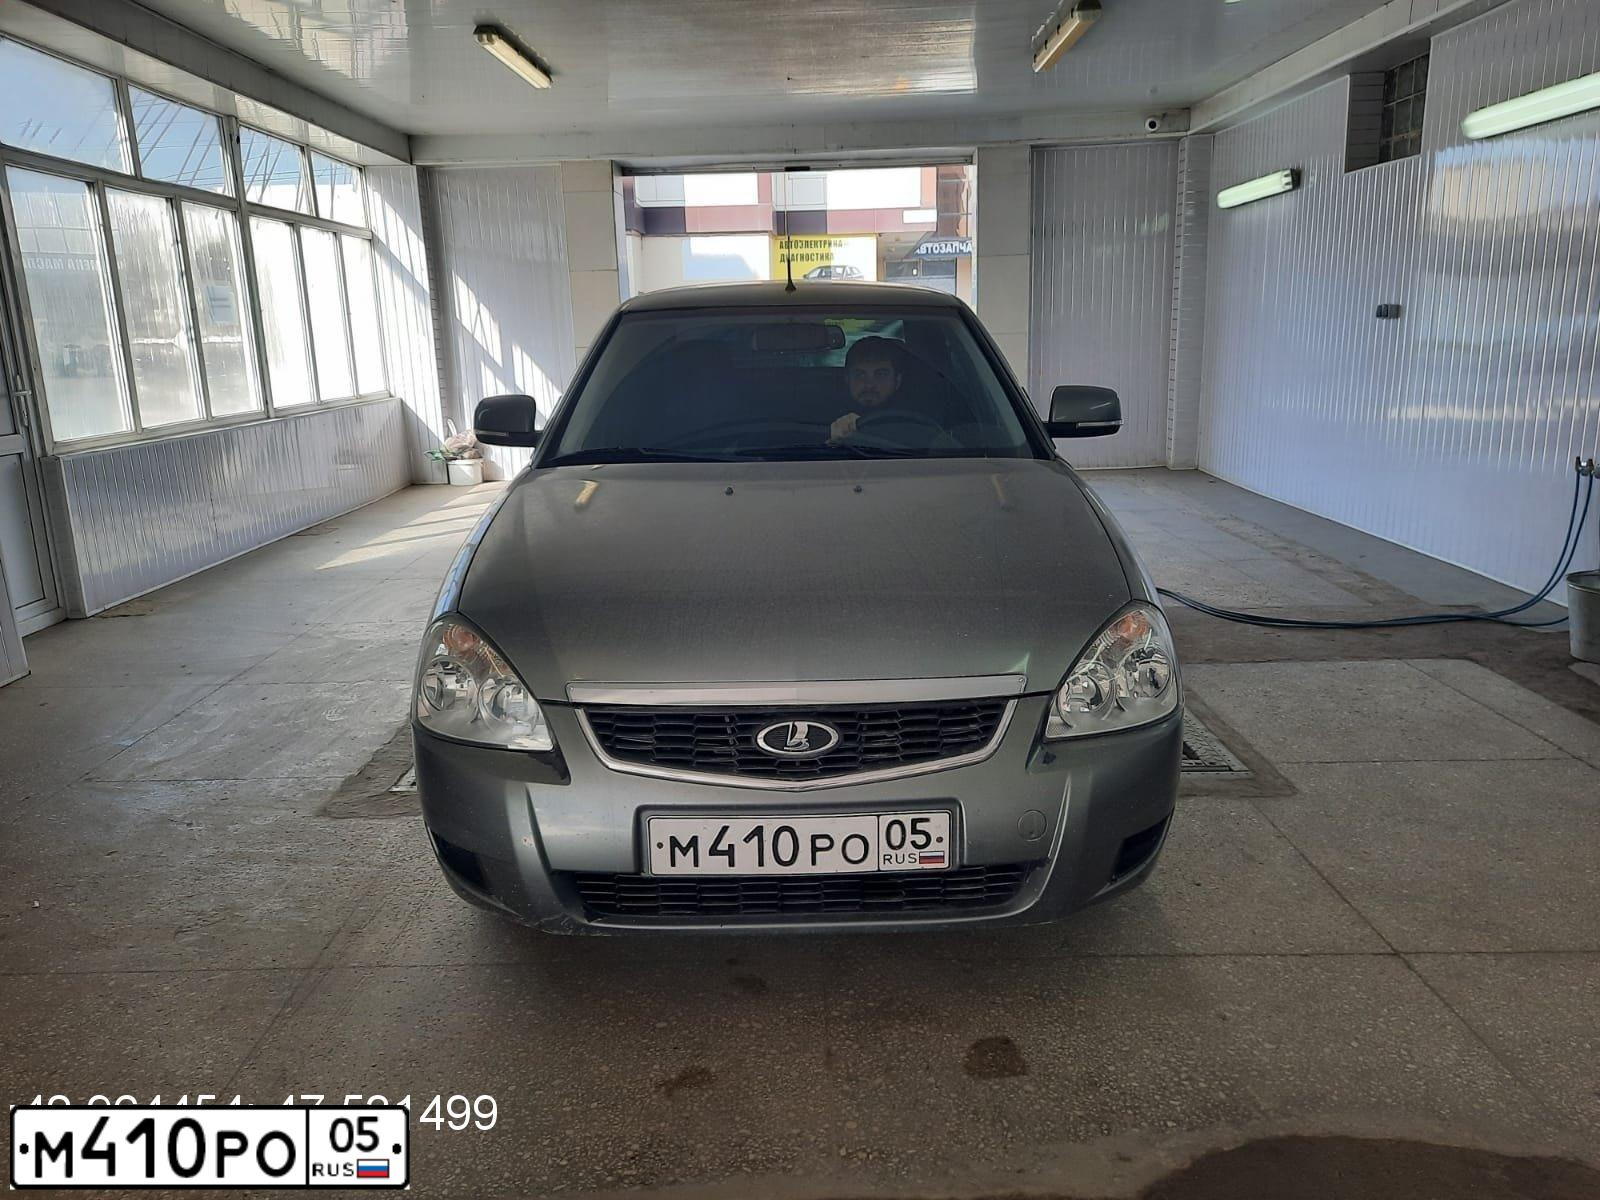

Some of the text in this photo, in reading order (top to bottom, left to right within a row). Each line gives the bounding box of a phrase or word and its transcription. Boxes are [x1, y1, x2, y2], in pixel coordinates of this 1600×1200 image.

[669, 817, 932, 868] М410РО 05
[883, 852, 917, 865] RUS
